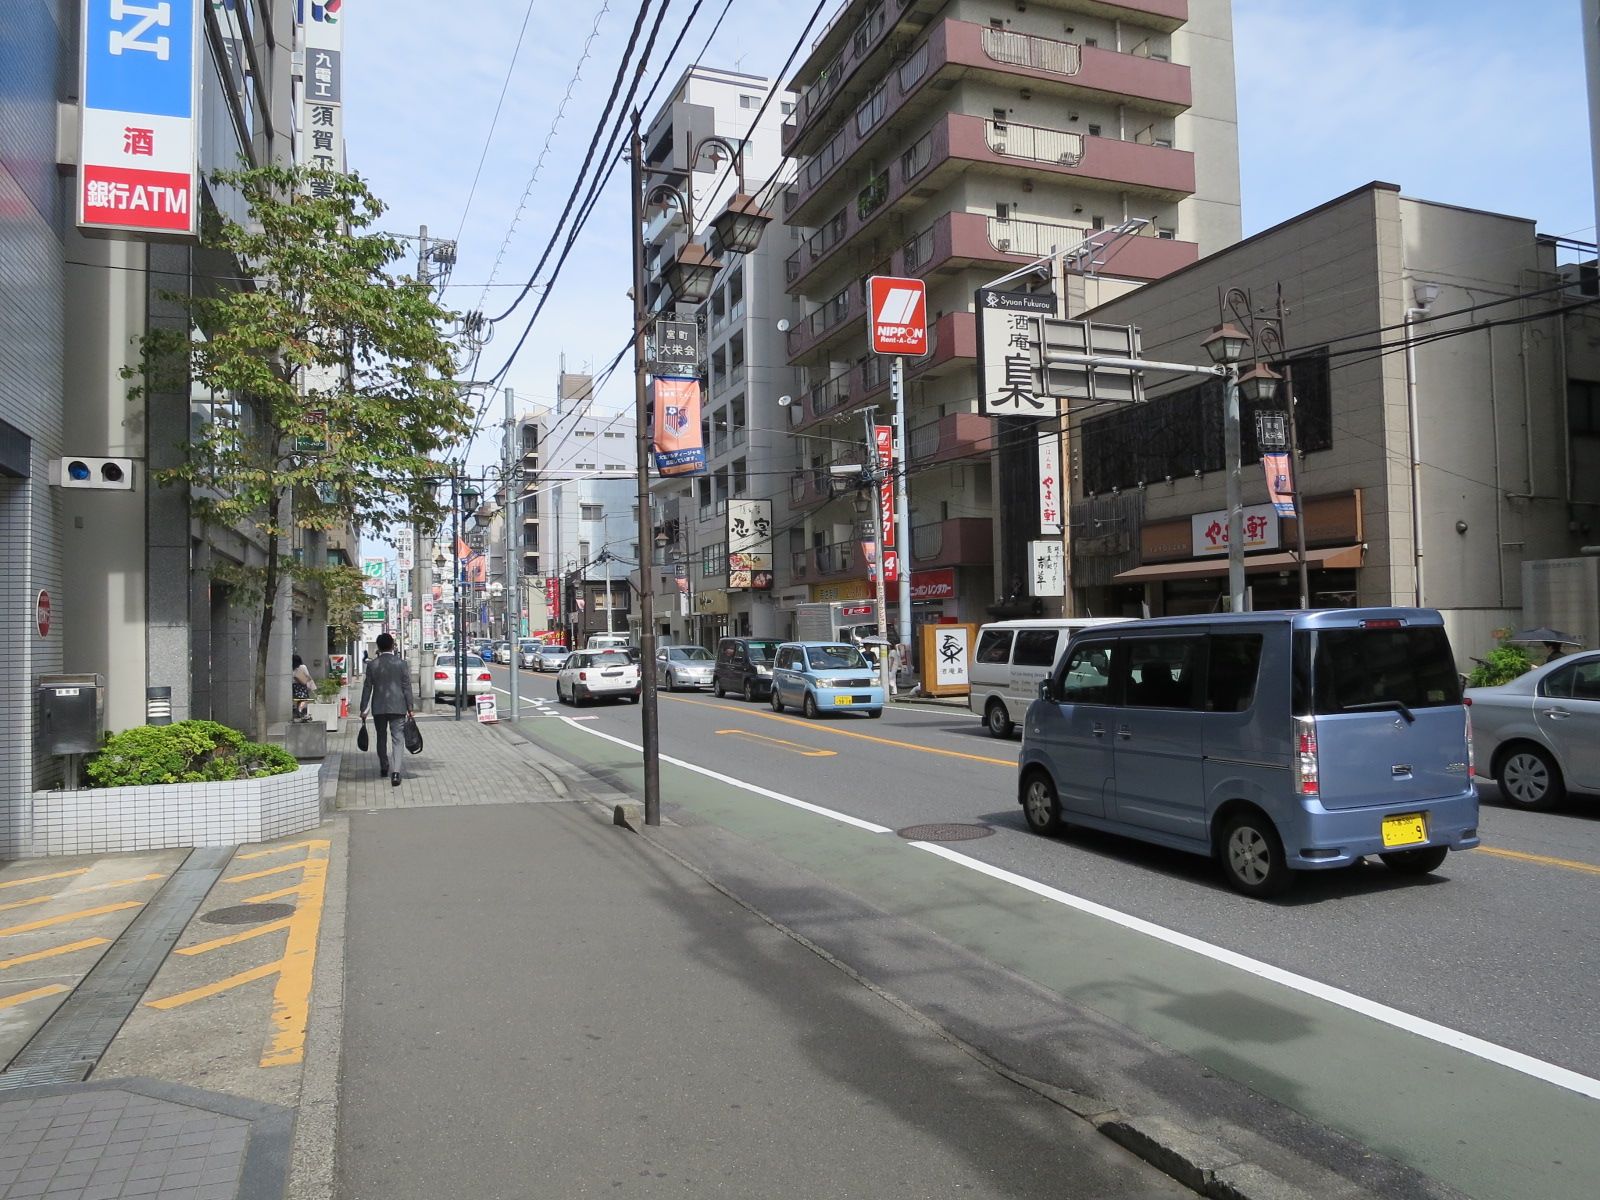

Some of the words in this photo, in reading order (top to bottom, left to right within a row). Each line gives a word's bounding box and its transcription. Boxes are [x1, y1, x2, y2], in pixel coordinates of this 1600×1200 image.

[315, 52, 332, 97] 九電工
[123, 126, 154, 156] 酒
[87, 179, 187, 214] 銀行ATM
[1000, 295, 1023, 306] Syuan
[1023, 298, 1050, 309] Fukurou
[877, 325, 923, 338] NIPPON
[880, 336, 918, 344] Rent-A-Car
[660, 343, 696, 356] 大栄会
[477, 701, 494, 715] P
